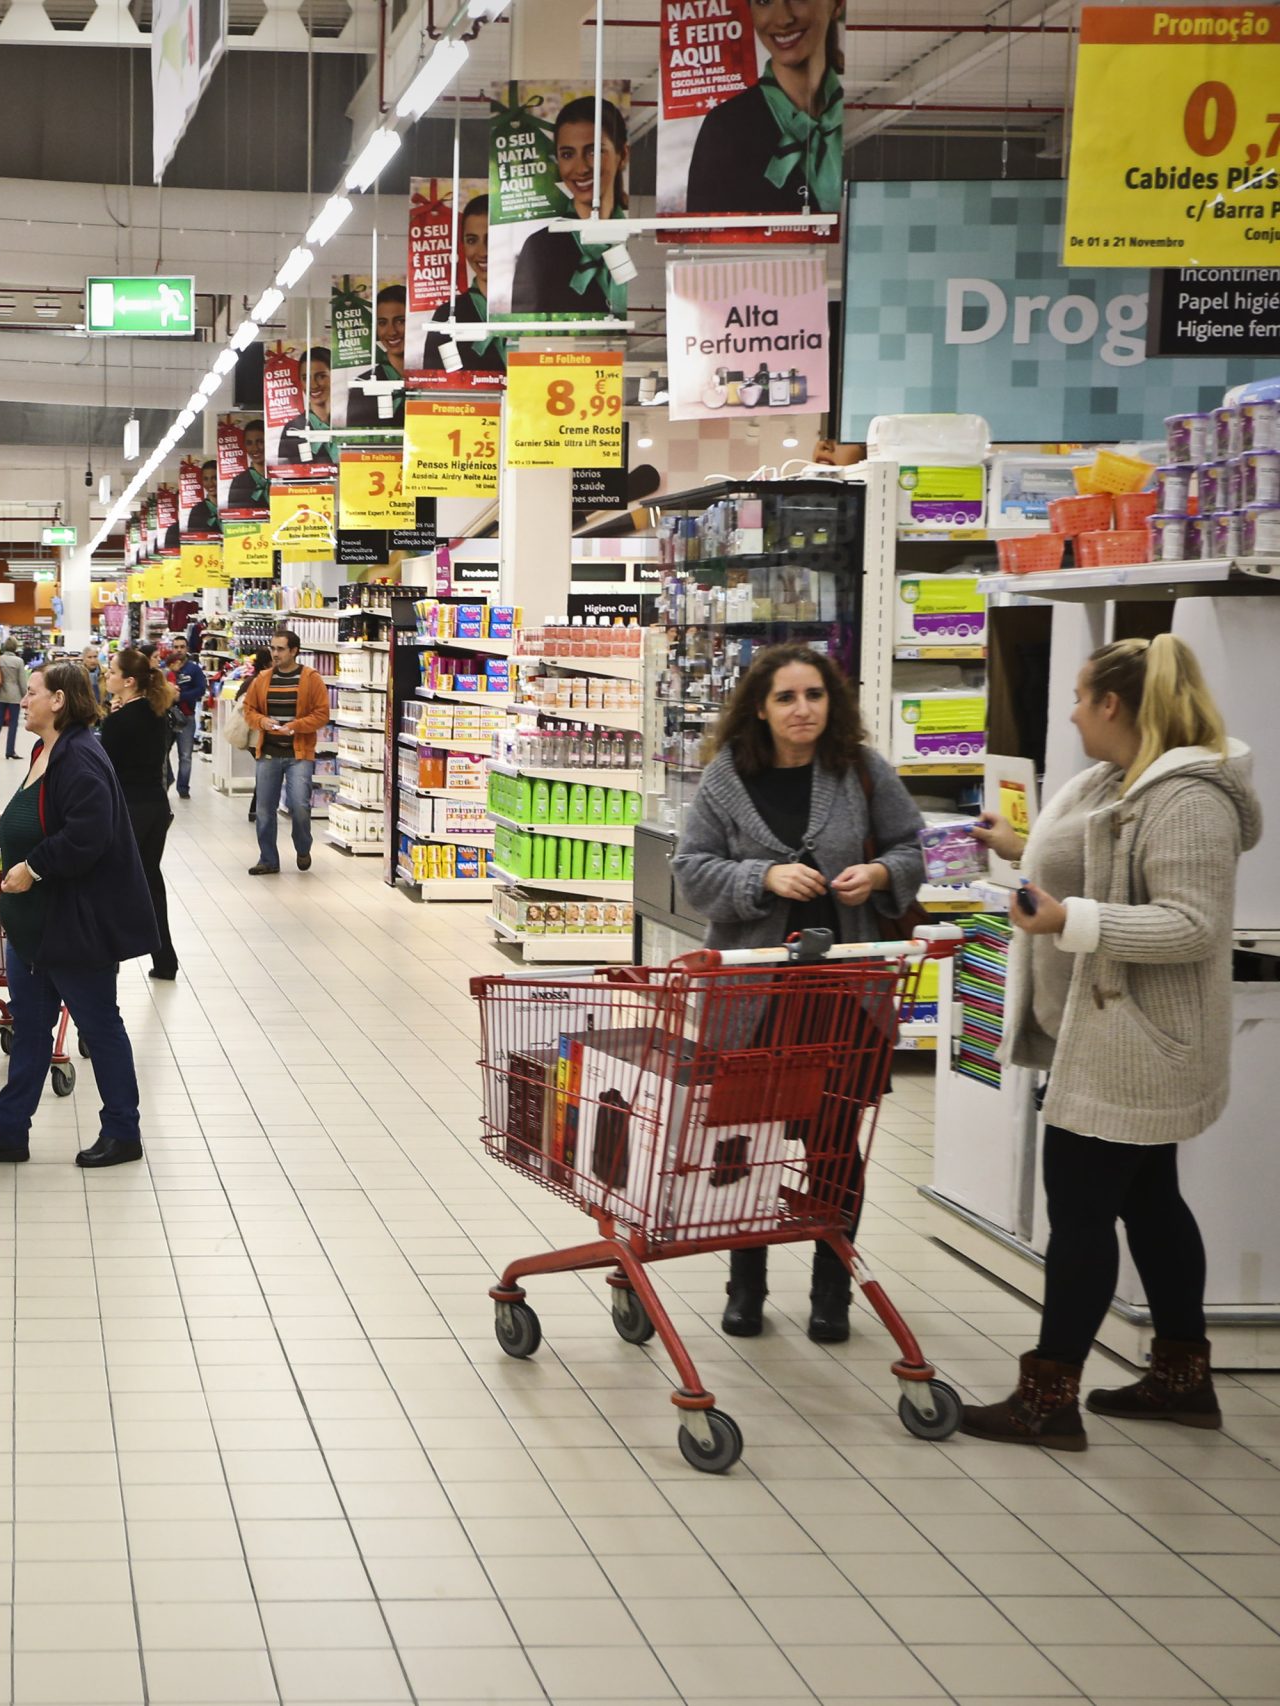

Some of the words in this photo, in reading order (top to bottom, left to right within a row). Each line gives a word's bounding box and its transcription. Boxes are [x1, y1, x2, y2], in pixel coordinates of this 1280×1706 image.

[667, 0, 732, 22] NATAL
[669, 23, 680, 46] É
[686, 21, 742, 44] FEITO
[1153, 11, 1270, 42] Promoção
[670, 45, 720, 68] AQUI
[495, 136, 506, 148] O
[509, 132, 535, 147] SEU
[497, 147, 540, 163] NATAL
[499, 163, 507, 180] É
[510, 161, 547, 177] FEITO
[501, 177, 533, 192] AQUI
[1125, 166, 1219, 190] Cabides
[1186, 200, 1207, 222] c/
[1213, 201, 1264, 219] Barra
[411, 227, 421, 238] O
[424, 224, 448, 237] SEU
[412, 238, 452, 252] NATAL
[1070, 237, 1083, 247] De
[1088, 237, 1100, 247] 01
[1103, 239, 1110, 247] a
[1113, 237, 1126, 247] 21
[1129, 237, 1184, 247] Novembro
[413, 253, 420, 267] É
[414, 267, 445, 281] AQUI
[1178, 292, 1229, 314] Papel
[335, 311, 342, 319] O
[344, 309, 361, 318] SEU
[724, 305, 778, 328] Alta
[337, 319, 365, 329] NATAL
[944, 278, 1149, 367] Drog
[337, 329, 343, 339] É
[345, 328, 369, 338] FEITO
[1177, 321, 1244, 343] Higiene
[338, 338, 361, 348] AQUI
[685, 329, 822, 356] Perfumaria
[540, 355, 554, 364] Em
[556, 354, 592, 364] Folheto
[274, 369, 290, 377] SEU
[471, 375, 499, 385] jumbo
[267, 378, 293, 389] NATAL
[595, 379, 606, 394] €
[268, 389, 273, 398] É
[274, 387, 298, 397] FEITO
[269, 397, 290, 408] AQUI
[546, 379, 621, 421] 8,99
[432, 404, 476, 415] Promoção
[559, 425, 589, 435] Creme
[592, 425, 621, 435] Rosto
[219, 443, 240, 451] NATAL
[448, 429, 495, 461] 1,25
[417, 460, 448, 469] Pensos
[451, 460, 497, 471] Higiénicos
[288, 487, 317, 495] Promoção
[580, 482, 606, 490] saúde
[588, 495, 620, 503] senhora
[225, 526, 257, 534] Novidade
[393, 538, 420, 546] Confeção
[584, 604, 617, 614] Higiene
[619, 604, 637, 613] Oral
